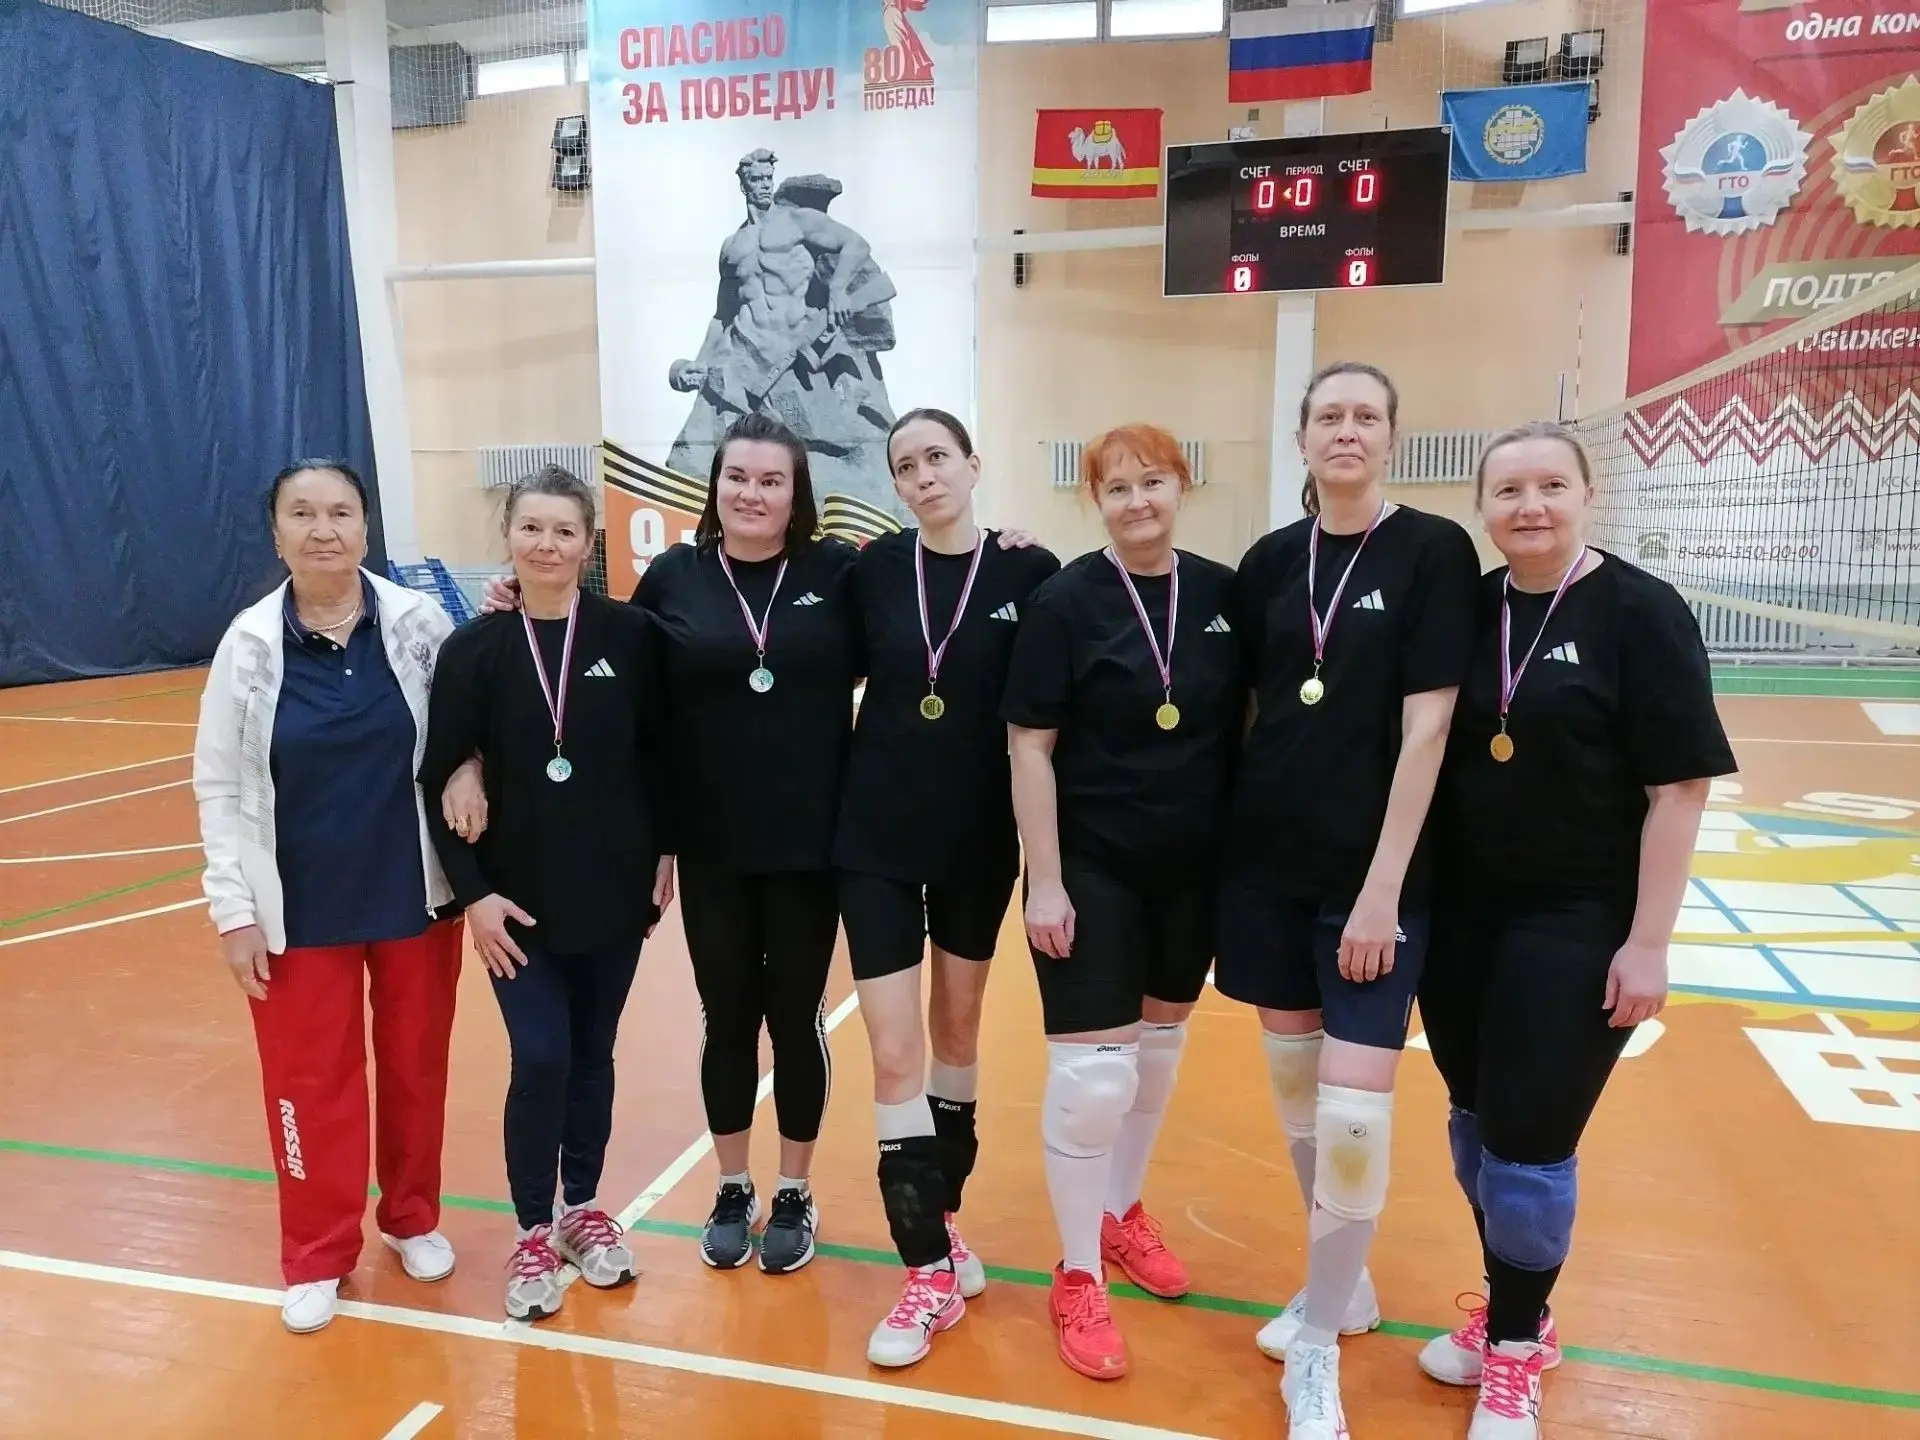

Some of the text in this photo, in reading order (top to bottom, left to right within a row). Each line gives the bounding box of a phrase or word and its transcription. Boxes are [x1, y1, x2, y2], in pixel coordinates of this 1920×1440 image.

[619, 14, 786, 70] СПАСИБО
[1785, 12, 1863, 41] одна
[863, 47, 901, 83] 80
[622, 67, 836, 125] ЗА ПОБЕДУ!
[863, 87, 935, 112] ПОБЕДА!
[1240, 159, 1371, 179] СЧЕТ ПЕРИОД СЧЕТ
[1718, 174, 1750, 190] ГТО
[1257, 174, 1375, 209] 0 0 0
[1279, 223, 1326, 238] ВРЕМЯ
[1231, 246, 1374, 264] ФОЛЫ ФОЛЫ
[1762, 271, 1902, 309] ПОДТ
[629, 508, 666, 577] 9
[279, 1098, 306, 1180] RUSSIA
